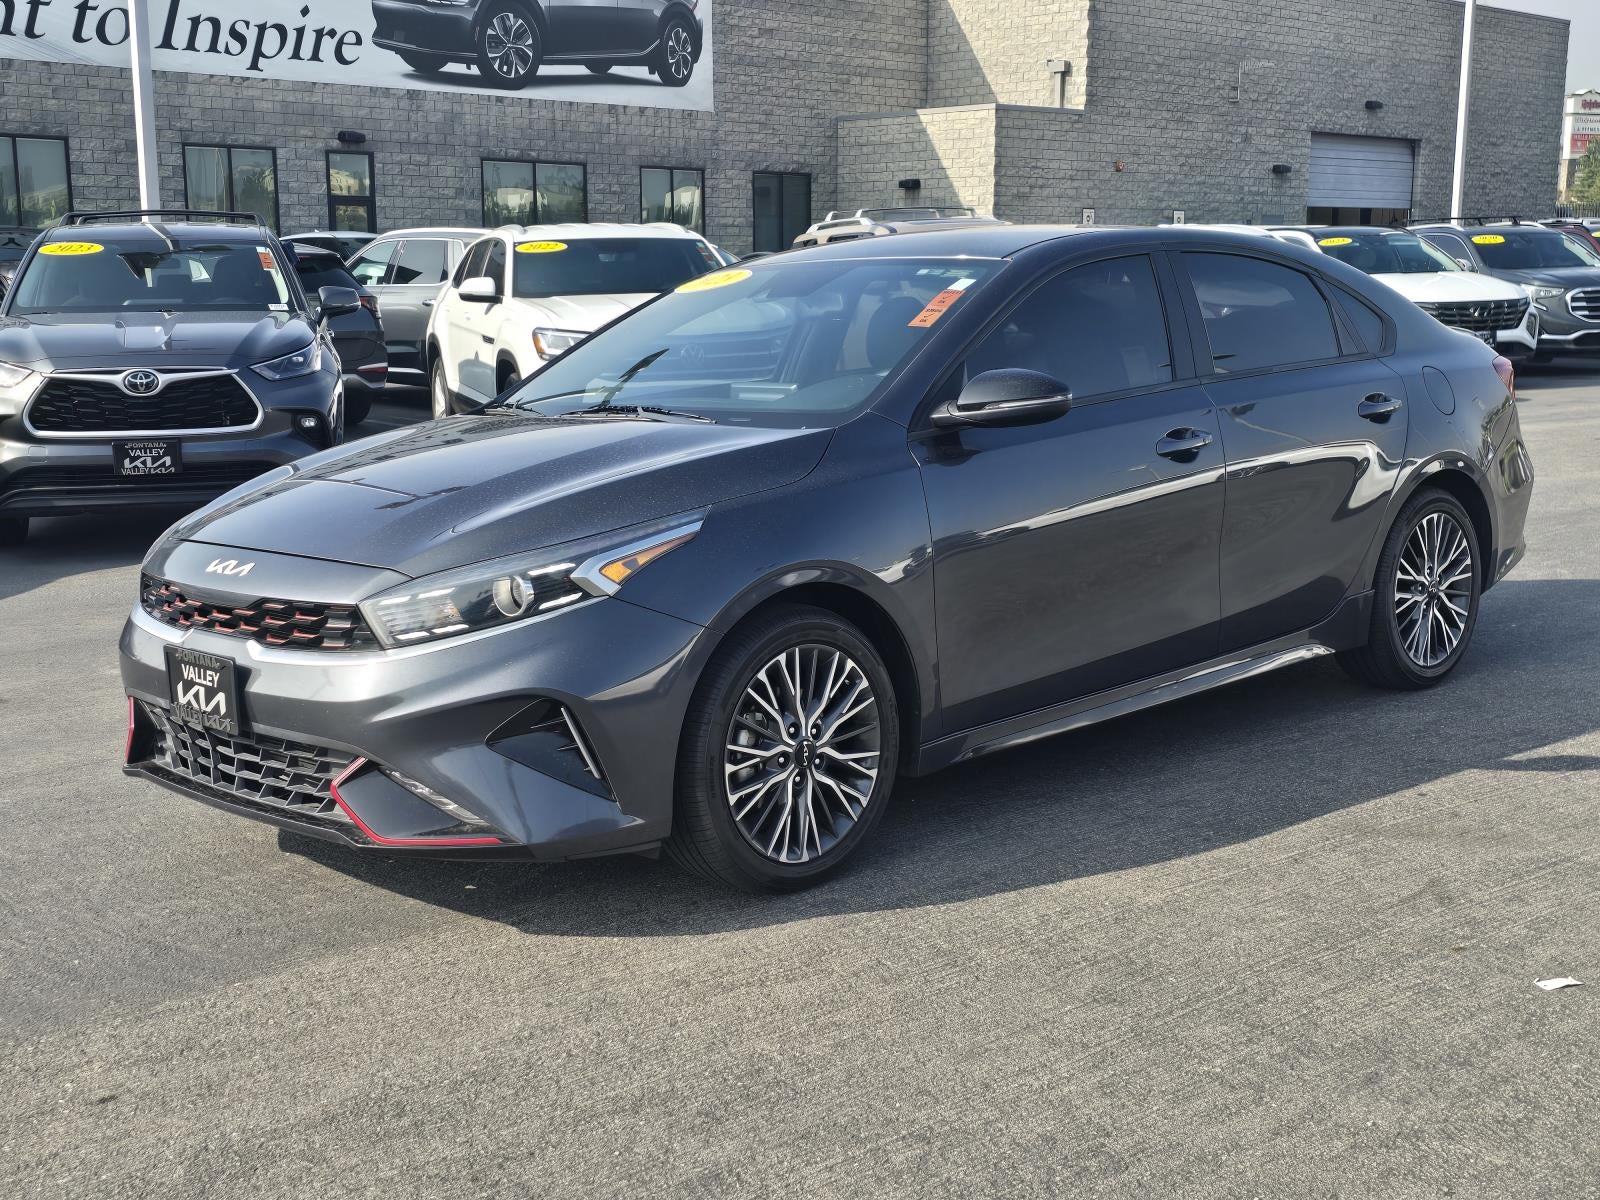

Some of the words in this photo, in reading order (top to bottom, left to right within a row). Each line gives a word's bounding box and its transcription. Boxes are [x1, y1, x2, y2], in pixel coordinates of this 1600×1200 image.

[72, 0, 130, 46] to
[154, 0, 363, 73] Inspire
[49, 243, 95, 253] 2023
[129, 448, 165, 456] VALLEY
[123, 456, 171, 469] KIA
[121, 467, 149, 476] VALLEY
[206, 558, 256, 577] KIA
[181, 663, 220, 688] VALLEY
[177, 680, 227, 717] KIA
